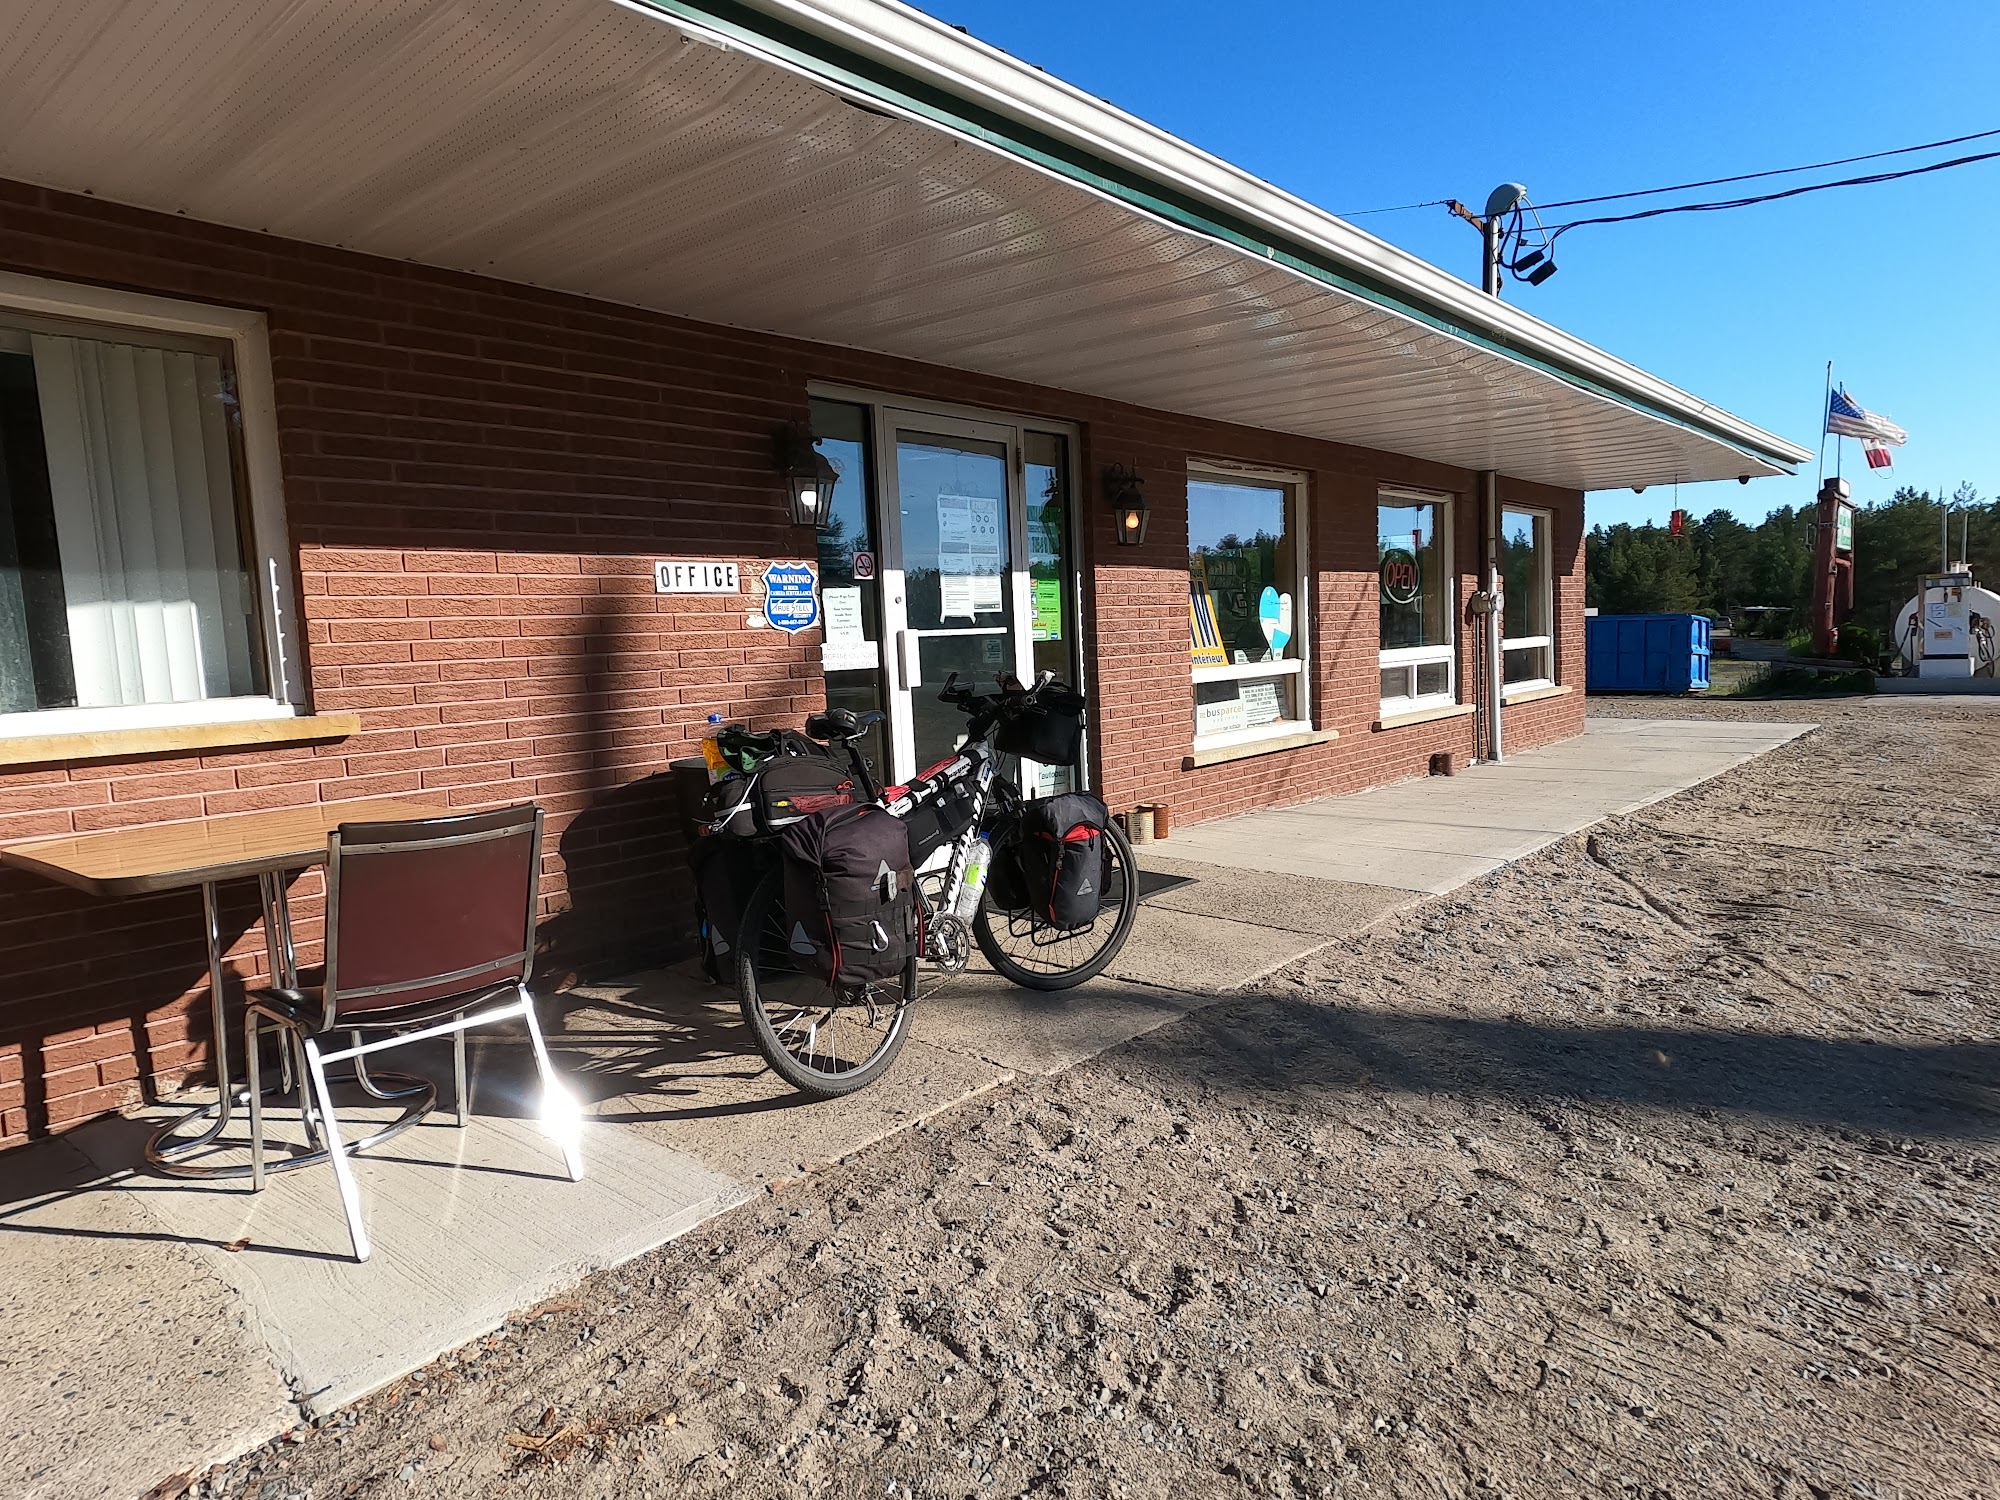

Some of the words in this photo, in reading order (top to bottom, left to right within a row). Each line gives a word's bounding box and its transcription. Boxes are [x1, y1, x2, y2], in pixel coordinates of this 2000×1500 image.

[660, 566, 734, 588] OFFICE
[768, 573, 811, 584] WARNING
[1386, 562, 1417, 590] OPEN
[791, 602, 810, 613] STEEL
[823, 652, 847, 661] ROPANE
[1206, 703, 1244, 718] busparcel
[1039, 770, 1066, 780] 'autobus
